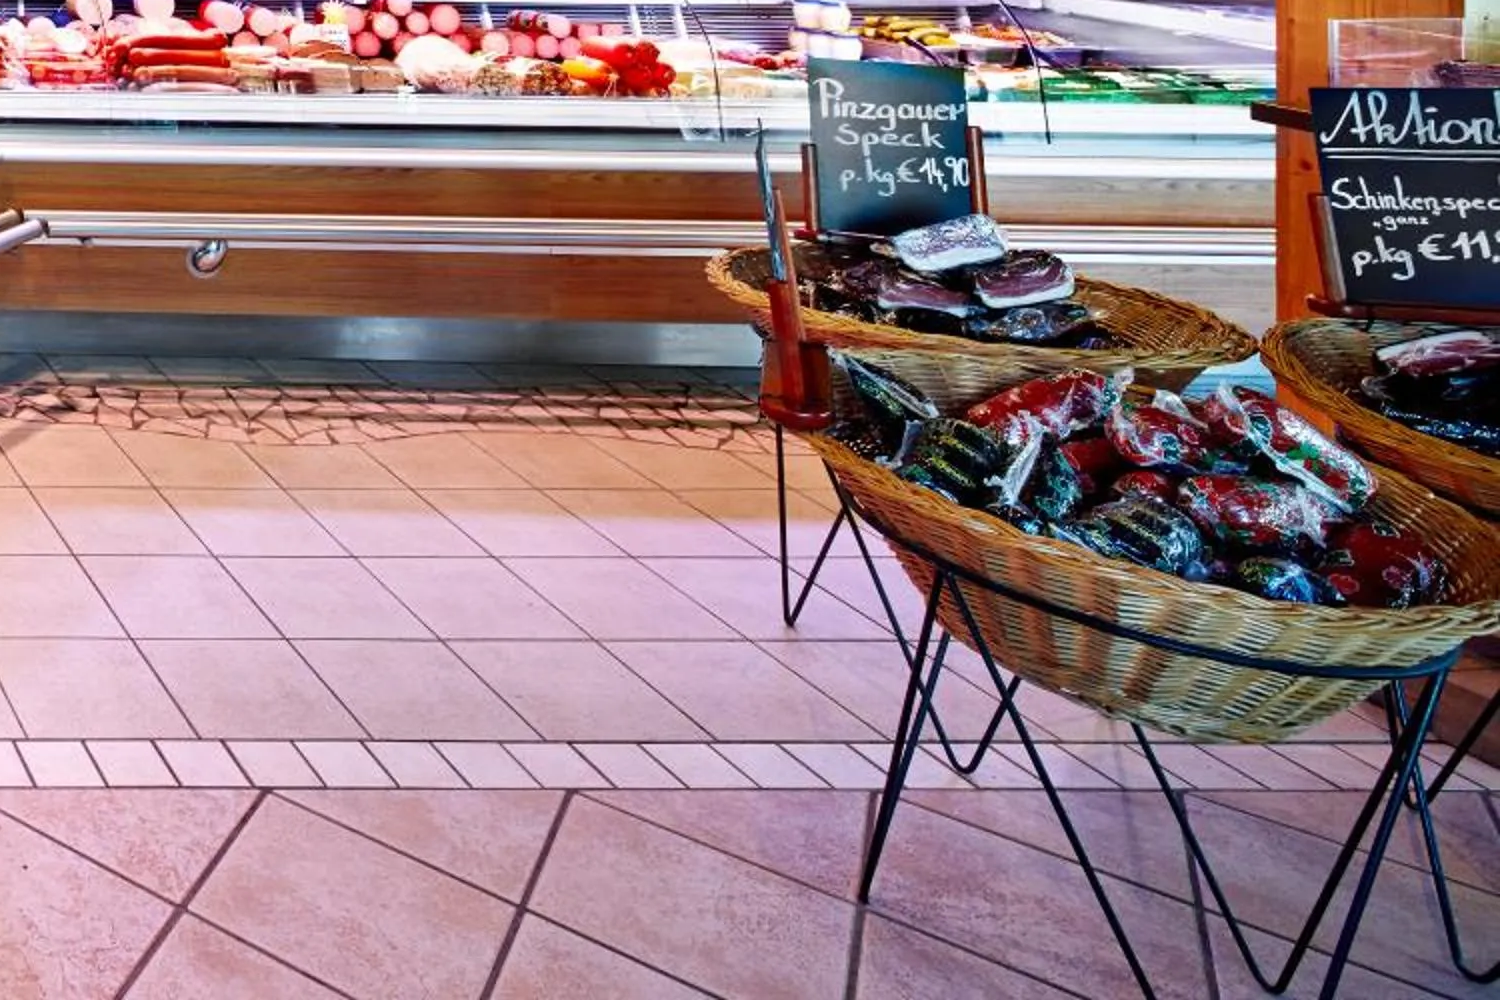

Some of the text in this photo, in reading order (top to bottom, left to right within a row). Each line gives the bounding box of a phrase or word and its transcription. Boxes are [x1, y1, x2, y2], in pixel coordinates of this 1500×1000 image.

[812, 77, 966, 132] Pinzgauer
[834, 121, 946, 157] Speck
[1331, 174, 1500, 219] Schinkenspec
